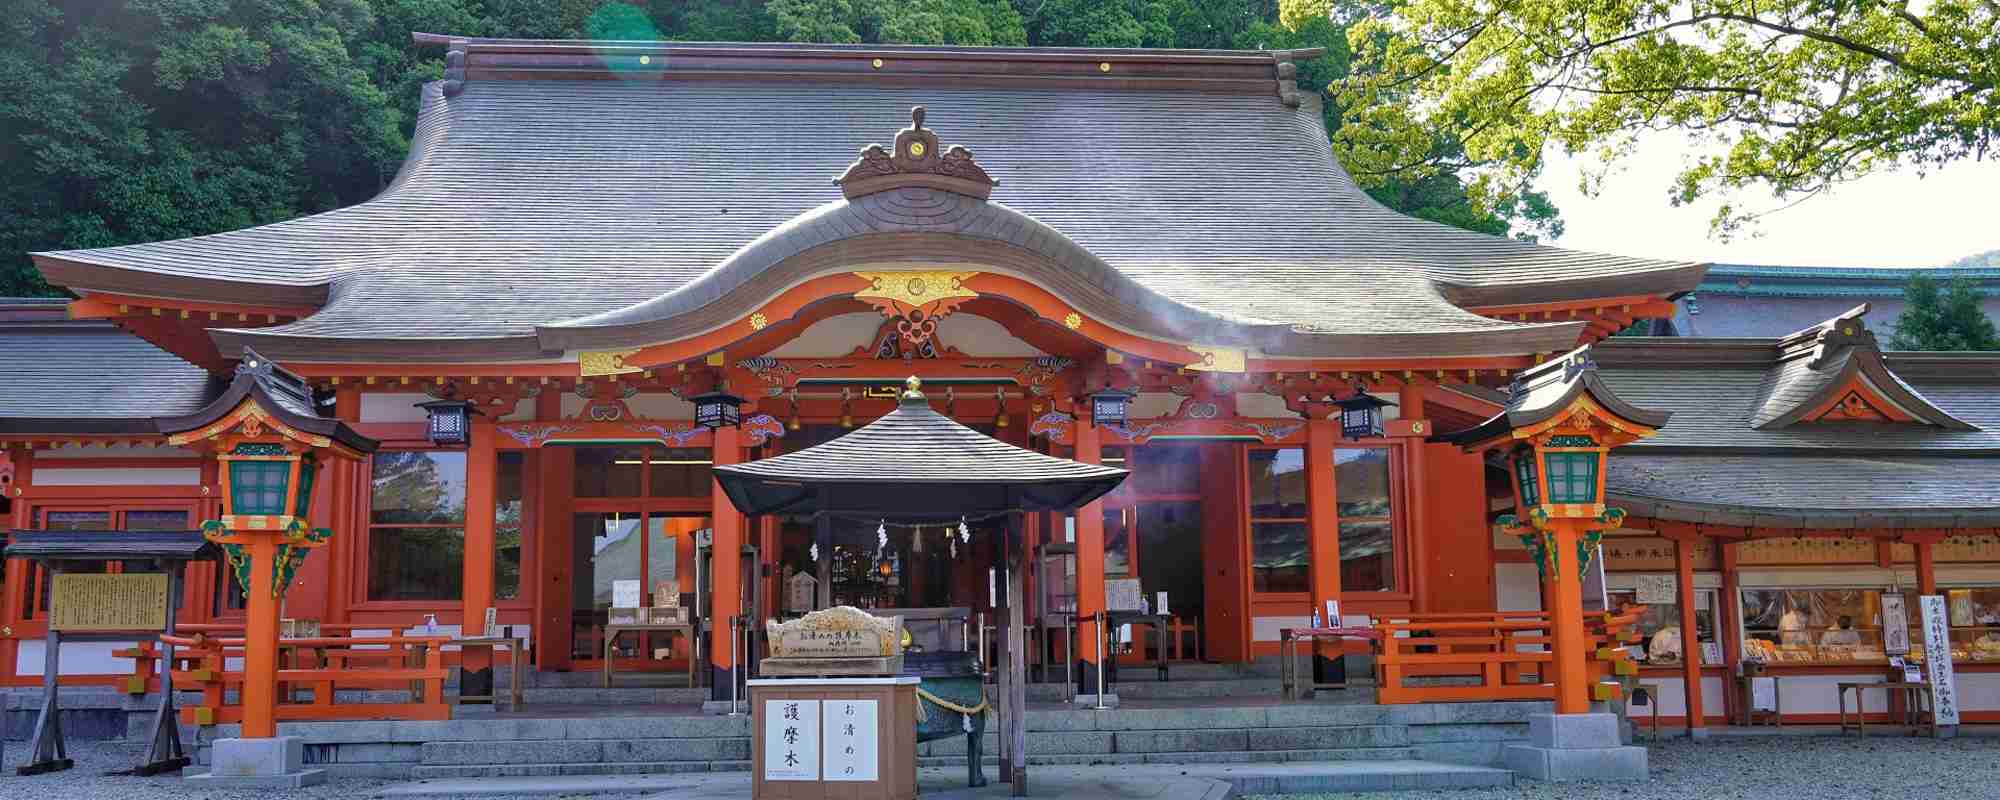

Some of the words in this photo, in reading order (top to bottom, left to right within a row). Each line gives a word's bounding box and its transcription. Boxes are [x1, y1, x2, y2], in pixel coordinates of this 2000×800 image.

[783, 703, 800, 768] 護摩木
[843, 703, 856, 775] お清めの
